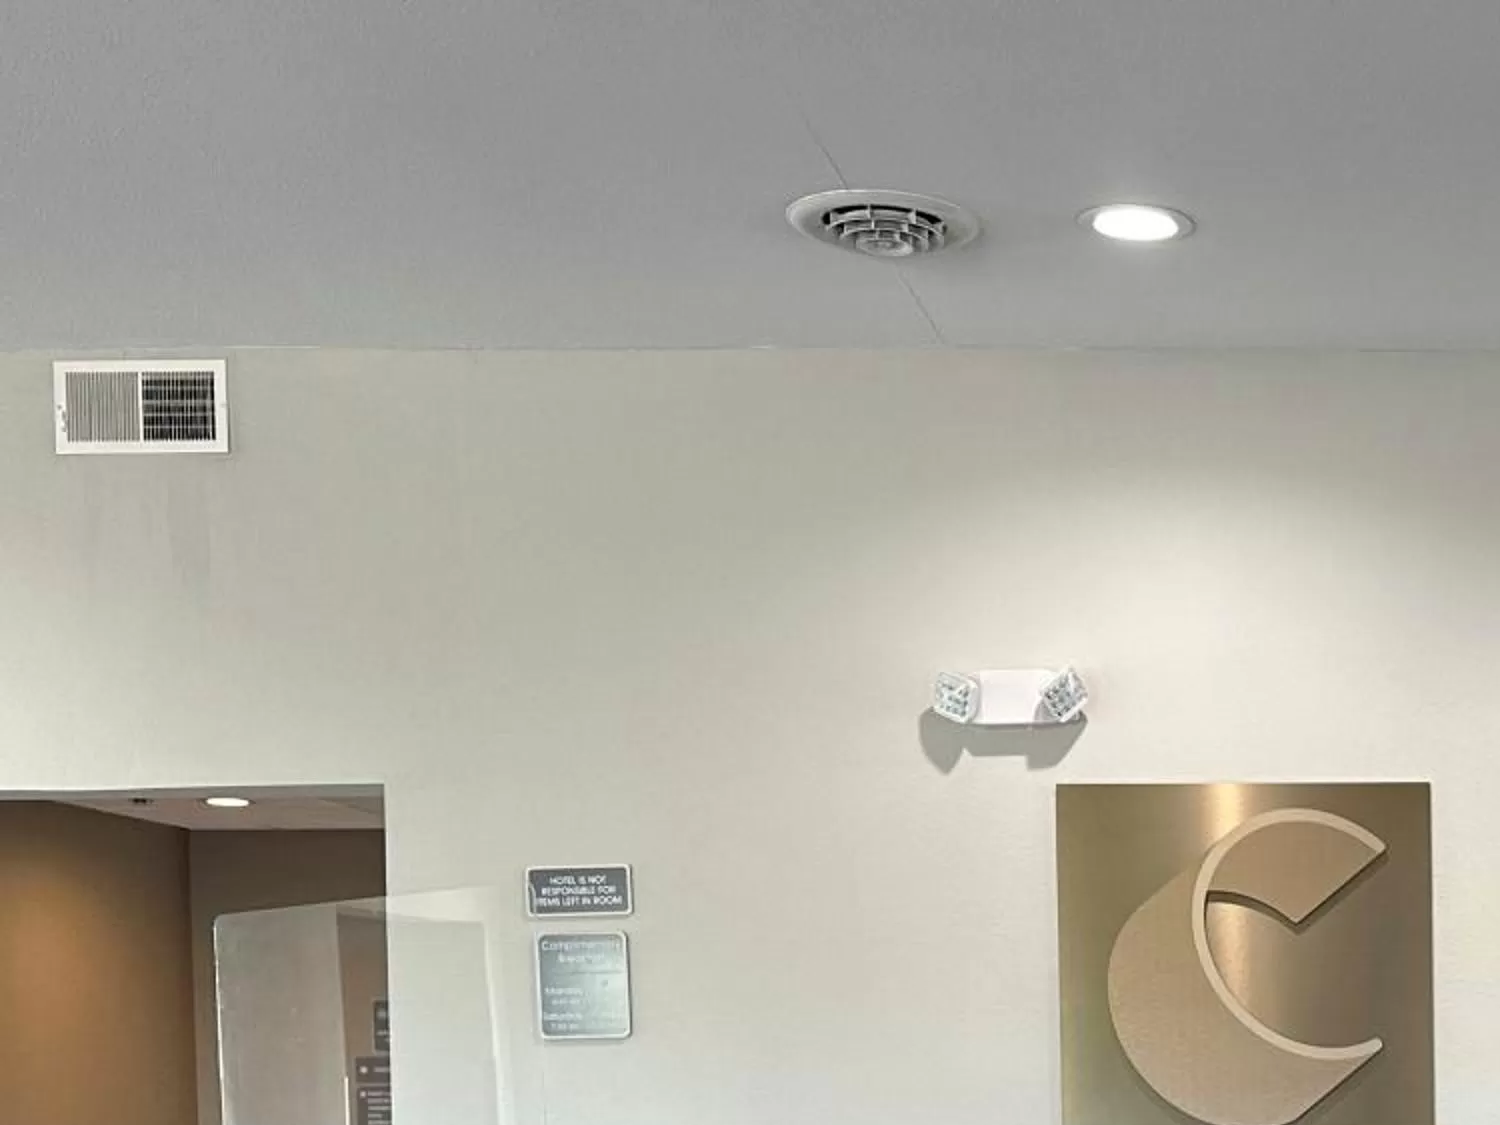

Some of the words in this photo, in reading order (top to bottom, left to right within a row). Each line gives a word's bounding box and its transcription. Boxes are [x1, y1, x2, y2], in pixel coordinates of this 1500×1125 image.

[549, 875, 576, 885] HOTEL
[588, 874, 607, 885] NOT
[541, 886, 596, 897] RESPONSIBLE
[598, 885, 617, 895] FOR
[593, 895, 622, 905] ROOM
